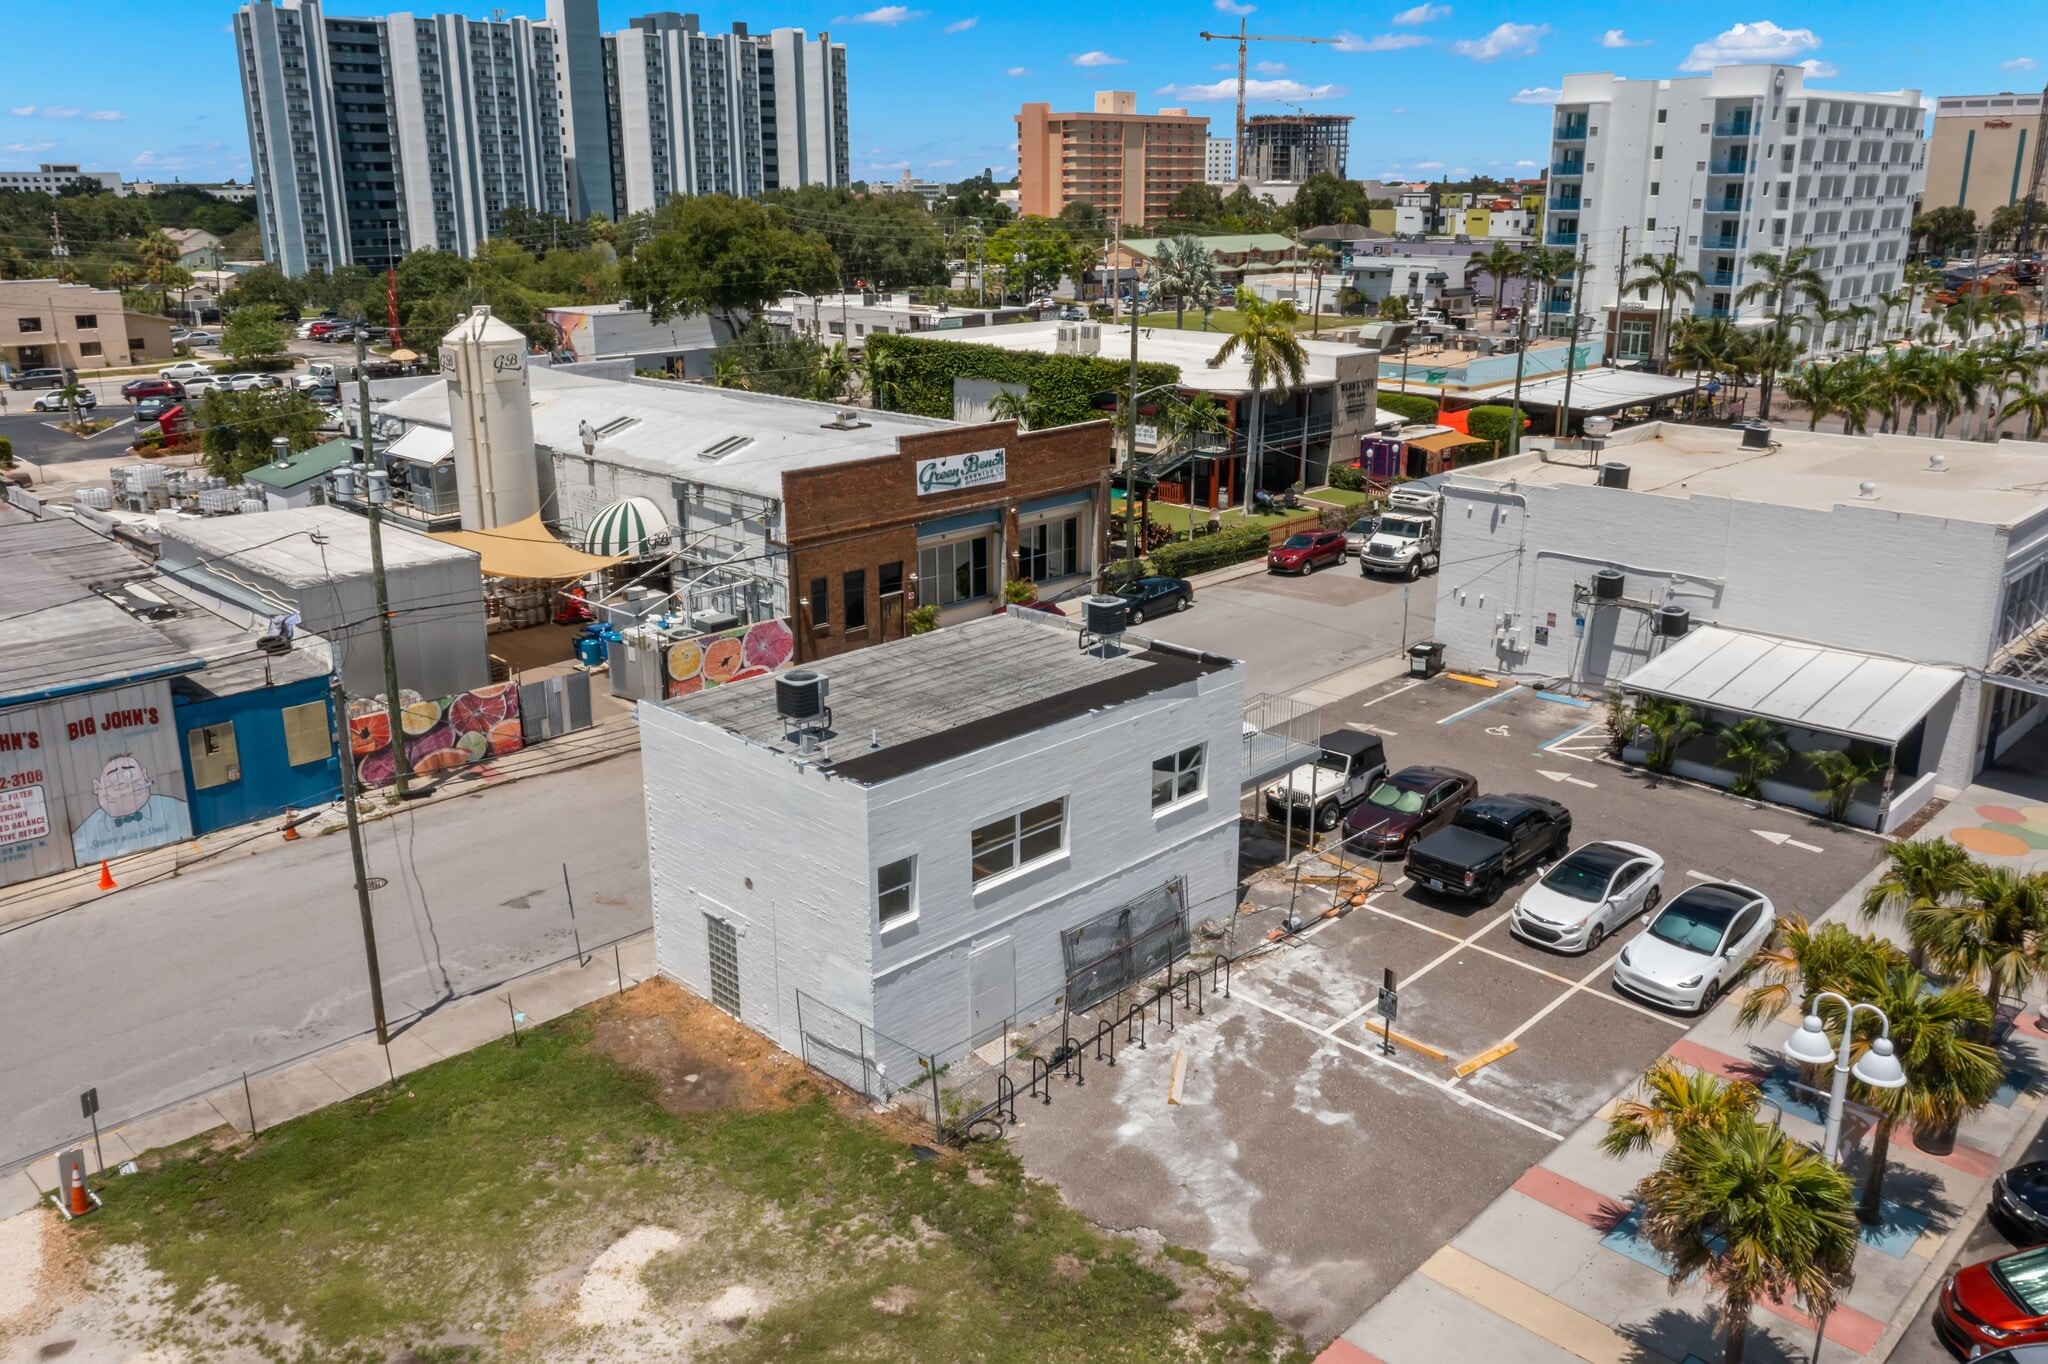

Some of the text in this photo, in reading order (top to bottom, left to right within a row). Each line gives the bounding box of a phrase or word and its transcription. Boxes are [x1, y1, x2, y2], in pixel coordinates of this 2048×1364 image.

[493, 353, 521, 373] GB
[919, 462, 961, 492] Green
[960, 450, 1004, 475] Bench
[67, 716, 97, 741] BIG
[101, 707, 160, 731] JOHN'S
[12, 816, 46, 830] BALANCE
[18, 826, 46, 838] REPAIR
